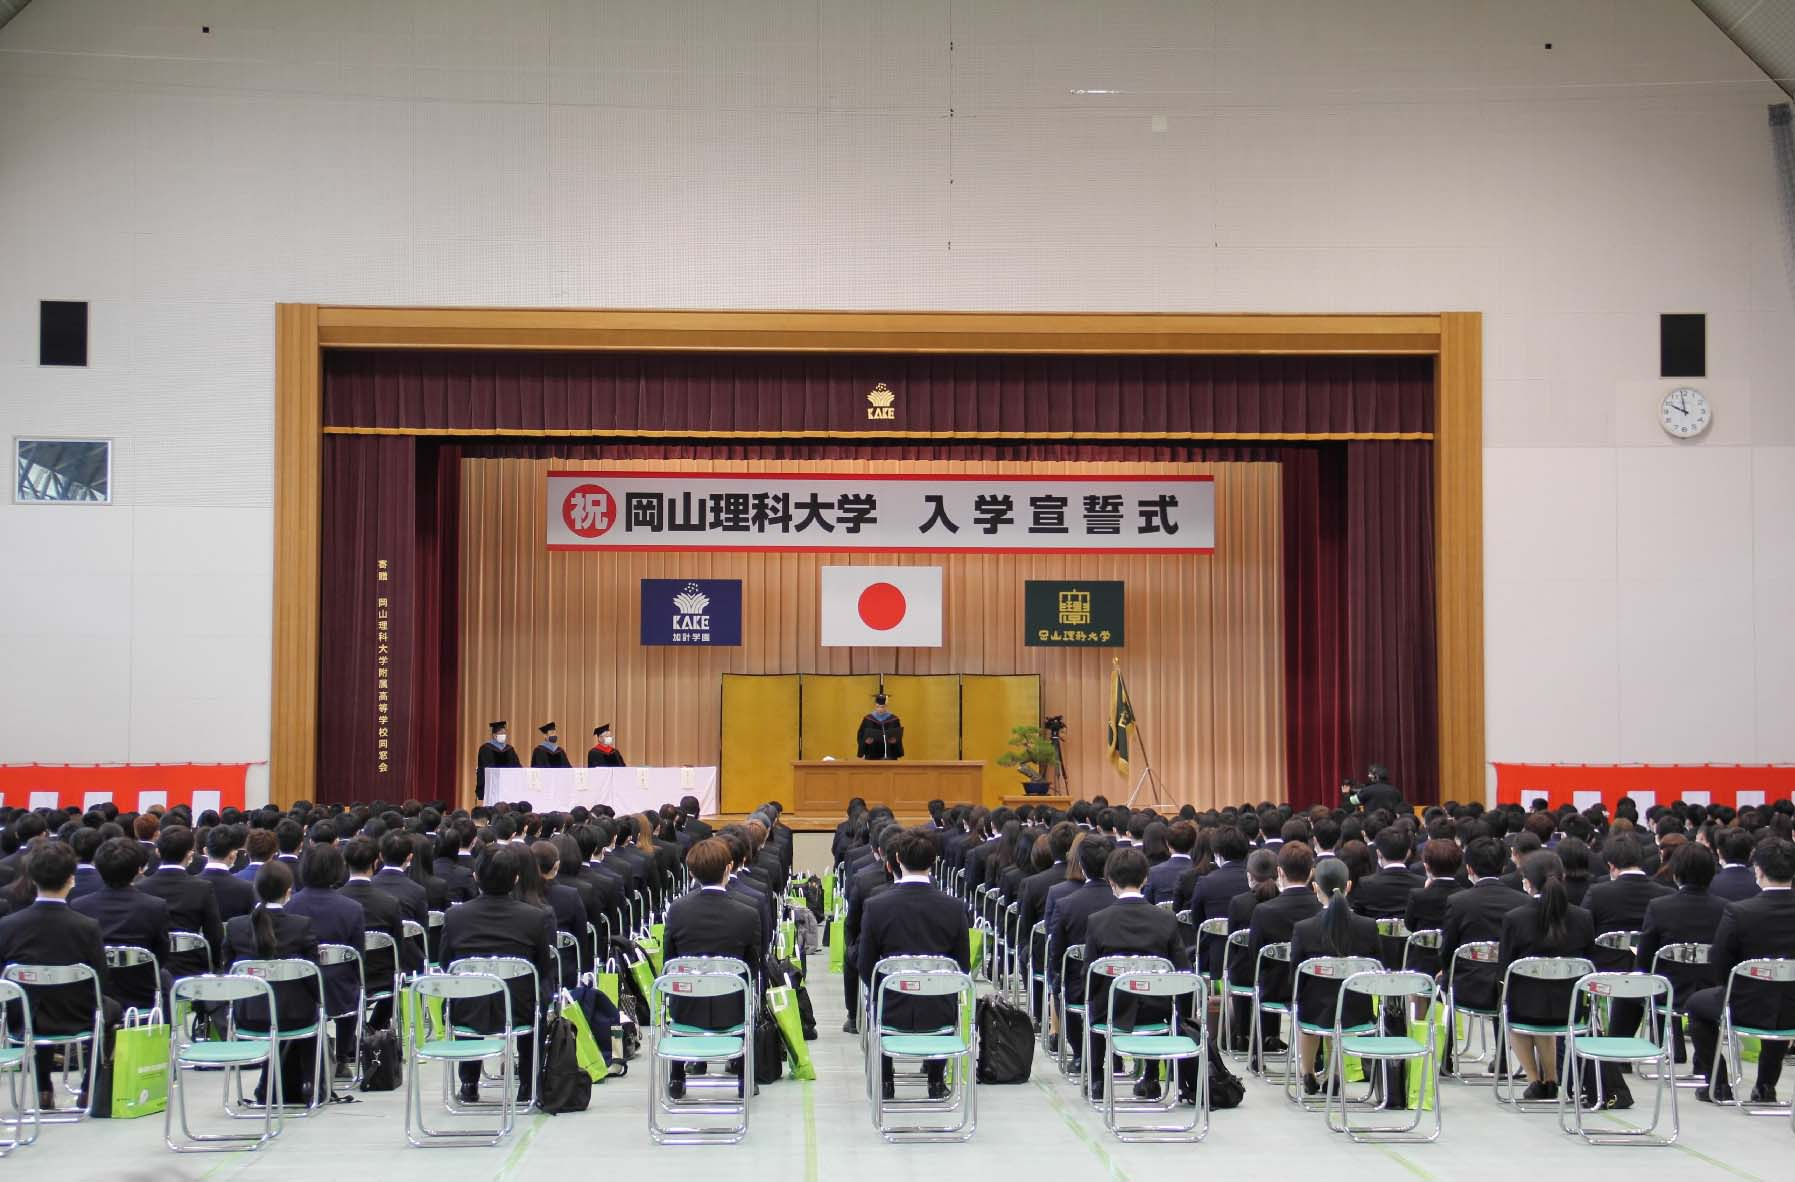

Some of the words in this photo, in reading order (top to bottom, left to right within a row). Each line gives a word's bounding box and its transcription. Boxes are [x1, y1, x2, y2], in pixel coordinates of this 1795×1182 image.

[867, 407, 895, 420] KAKE
[571, 493, 608, 530] 祝
[625, 492, 878, 533] 岡山理科大学
[918, 494, 1179, 535] 入学宣誓式
[672, 615, 710, 630] KAKE
